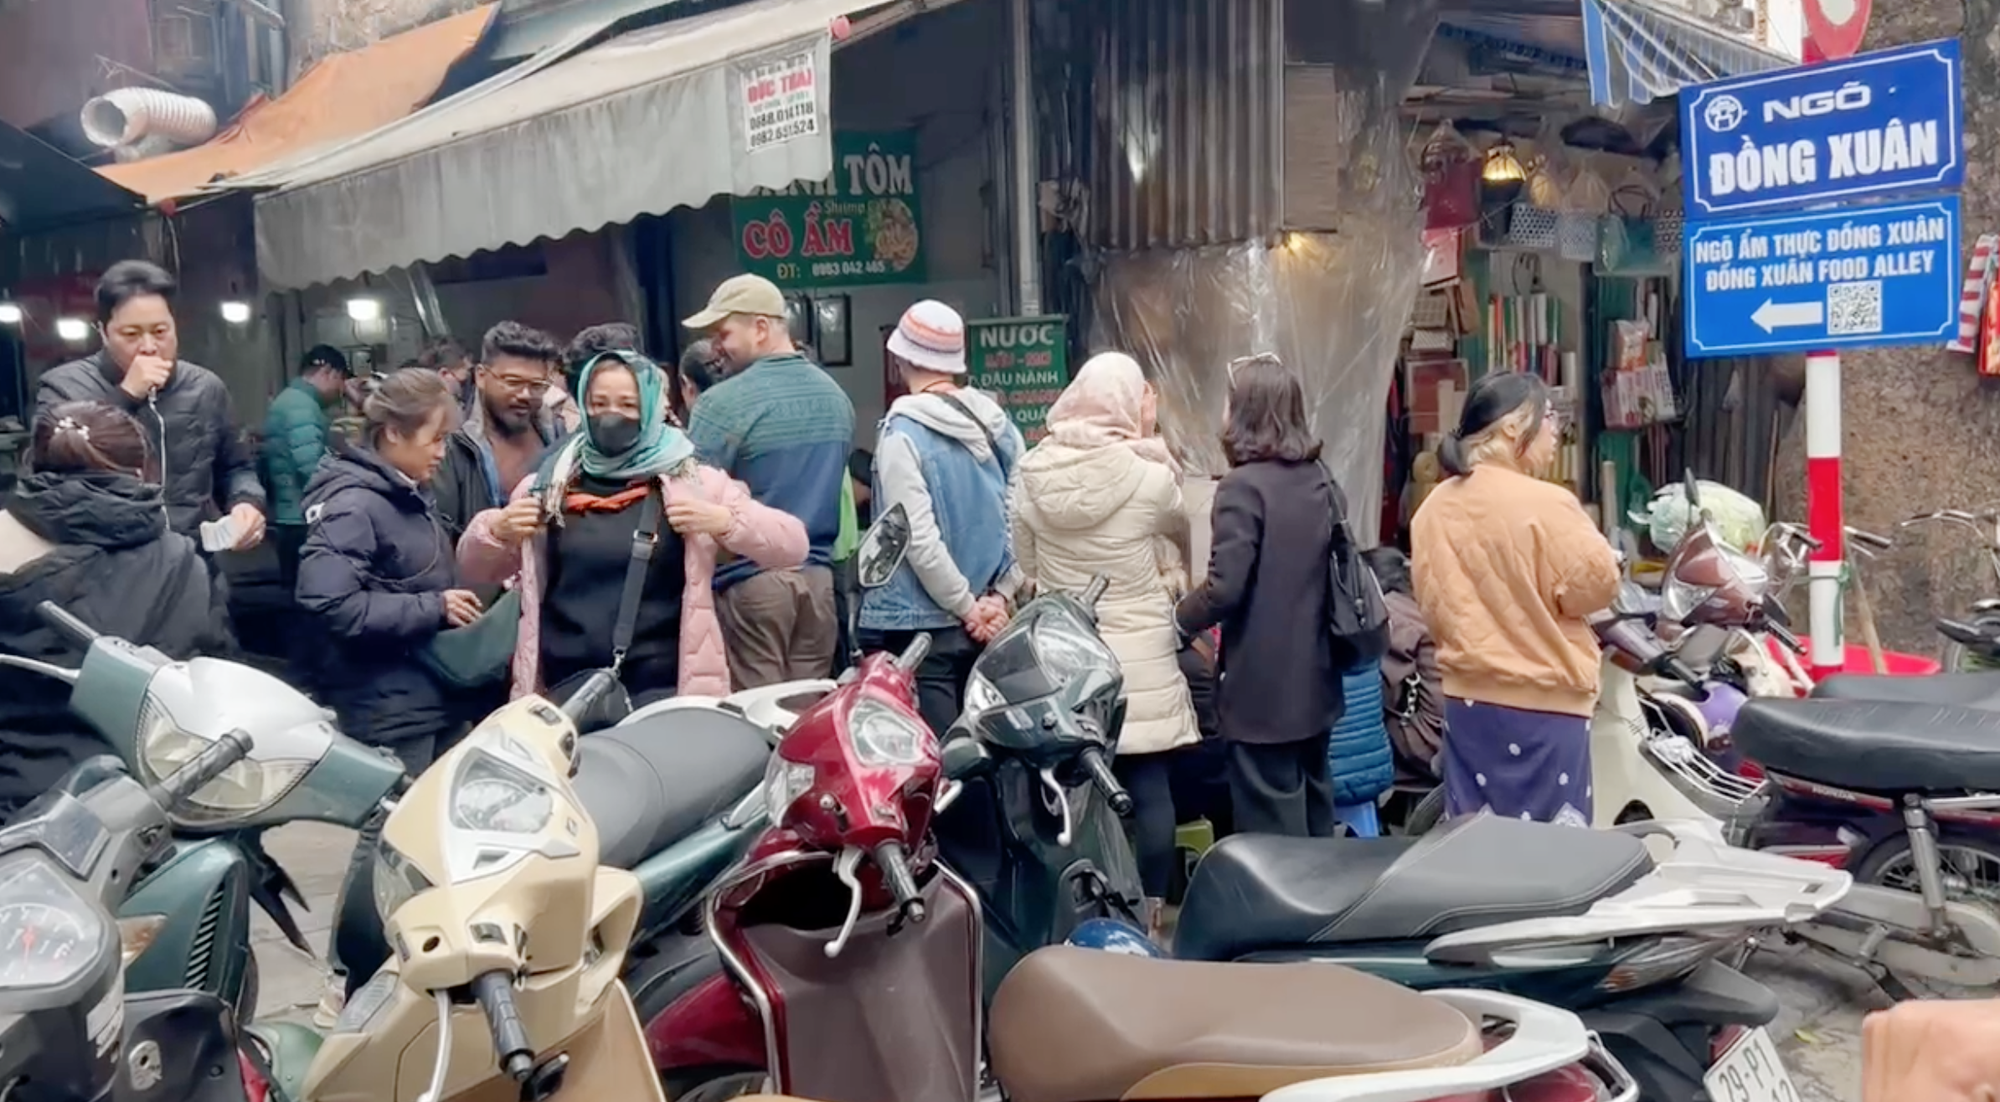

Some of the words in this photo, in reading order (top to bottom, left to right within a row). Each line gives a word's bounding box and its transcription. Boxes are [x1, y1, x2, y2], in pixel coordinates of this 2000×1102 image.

[1763, 81, 1871, 122] NGÕ
[843, 142, 913, 195] TÔM
[1709, 135, 1817, 196] ĐỒNG
[1827, 118, 1938, 179] XUÂN
[743, 208, 793, 258] CÔ
[1887, 214, 1944, 245] XUÂN
[1762, 257, 1813, 287] XUÂN
[1819, 256, 1869, 281] FOOD
[1874, 250, 1935, 277] ALLEY
[1812, 786, 1857, 801] HONDA
